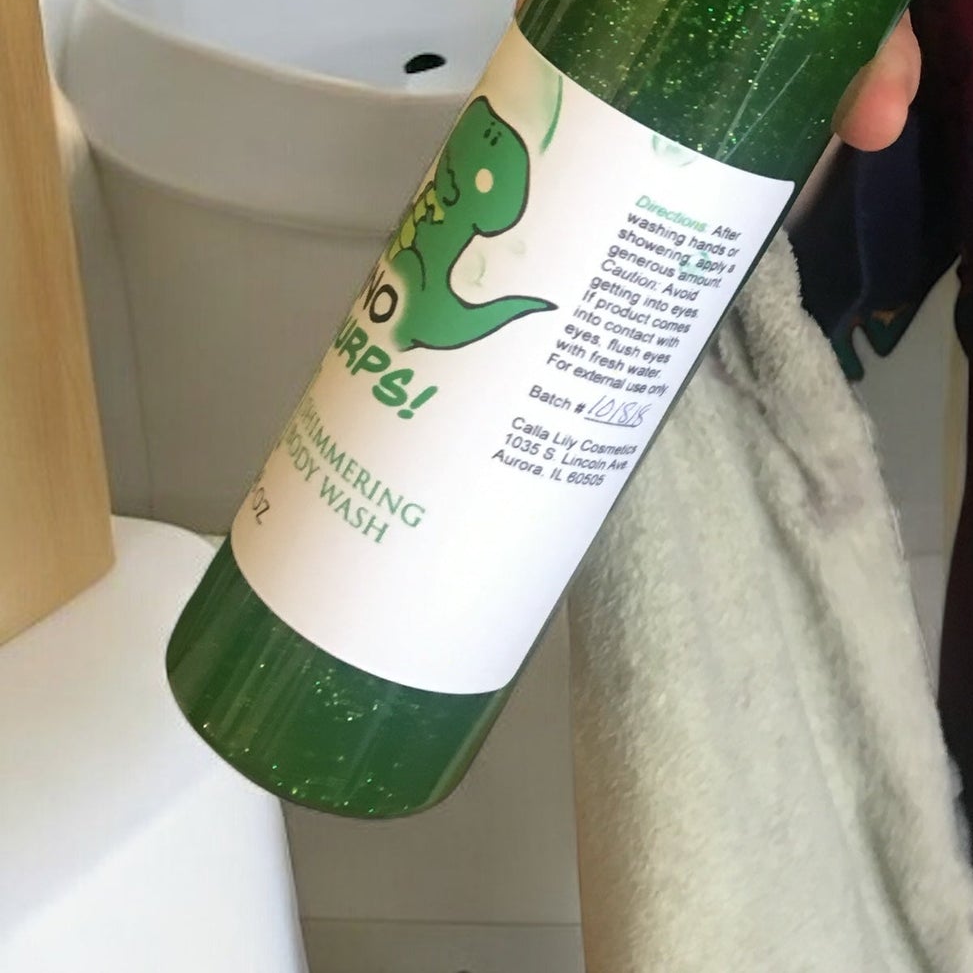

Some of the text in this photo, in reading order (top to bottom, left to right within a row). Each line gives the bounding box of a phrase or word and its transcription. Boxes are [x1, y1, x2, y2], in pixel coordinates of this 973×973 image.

[627, 212, 740, 258] washing hands or
[635, 194, 742, 240] Directions After
[601, 259, 700, 301] Caution: Avoid
[607, 244, 676, 278] generous
[696, 258, 727, 274] apply
[727, 264, 736, 273] a
[583, 290, 691, 334] If product comes
[590, 276, 641, 306] getting
[643, 298, 669, 313] into
[573, 306, 680, 349] into contact with
[556, 338, 587, 359] with
[588, 350, 625, 372] fresh
[606, 338, 642, 358] flush
[643, 351, 671, 365] eyes
[546, 352, 573, 372] For
[573, 365, 627, 390] external
[625, 381, 648, 394] use
[529, 384, 586, 414] Batch #
[504, 433, 541, 456] 1035
[561, 452, 607, 471] Lincoln
[511, 416, 638, 456] Calla Lily Cosmetics
[549, 467, 562, 482] IL
[566, 471, 606, 486] 60505
[319, 475, 389, 545] WASH
